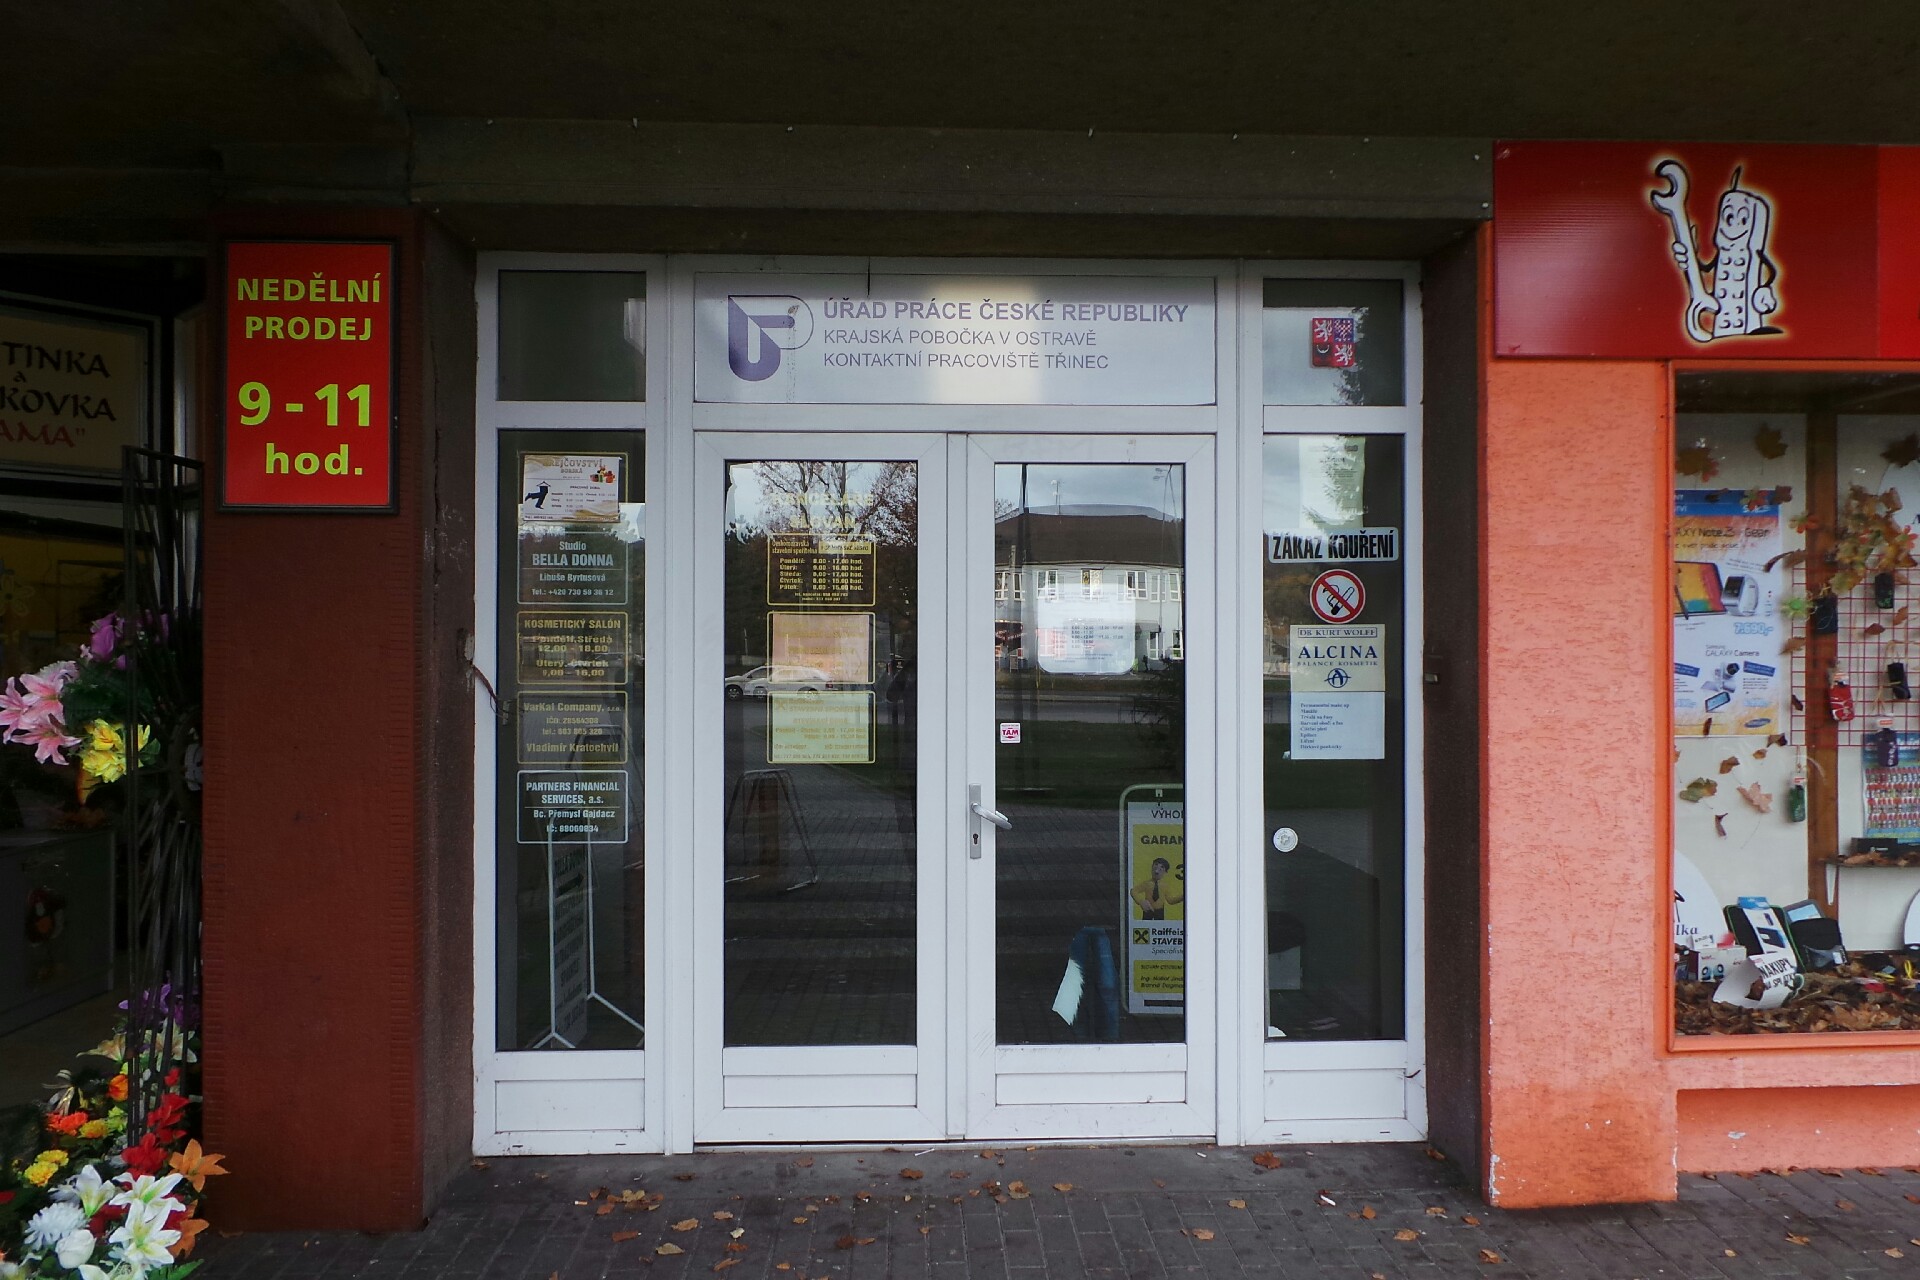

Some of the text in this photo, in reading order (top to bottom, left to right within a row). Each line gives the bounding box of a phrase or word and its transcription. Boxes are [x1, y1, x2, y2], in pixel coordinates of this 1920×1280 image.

[237, 272, 381, 303] NEDĚLNÍ
[823, 297, 1189, 323] ÚŘAD PRÁCE ČESKÉ REPUBLIKY
[245, 316, 372, 342] PRODEJ
[824, 327, 1097, 347] KRAJSKÁ POBOČKA V OSTRAVĚ
[824, 350, 1110, 370] KONTAKTNÍ PRACOVIŠTĚ TŘINEC
[238, 381, 371, 427] 9 - 11
[265, 443, 363, 476] hod.
[1745, 527, 1770, 537] Gear
[559, 541, 587, 551] Studio
[1273, 529, 1394, 559] ZÁKAZ KOUŘENÍ
[532, 553, 614, 566] BELLA DONNA
[539, 573, 566, 582] Libuše
[524, 618, 621, 629] KOSMETICKÝ SALÓN
[1298, 645, 1378, 658] ALCINA
[1734, 649, 1760, 657] Camera
[526, 743, 619, 752] Vladimír Kratochvíl
[526, 782, 620, 791] PARTNERS FINANCIAL
[541, 794, 604, 804] SERVICES, a.s.
[533, 809, 616, 819] Bc. Přemysl Gajdacz
